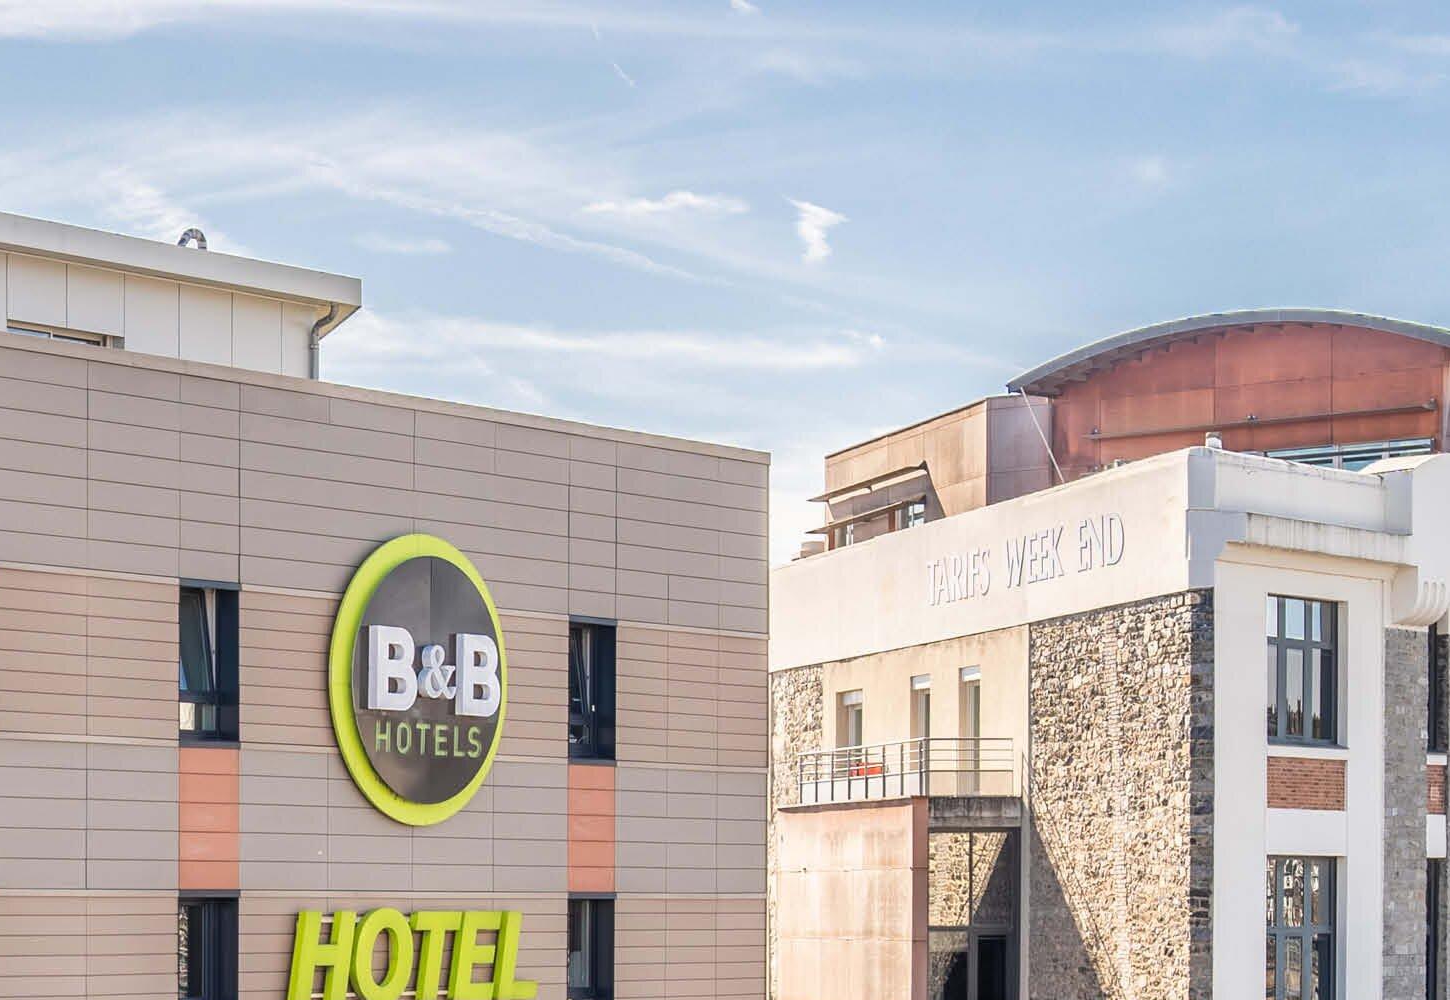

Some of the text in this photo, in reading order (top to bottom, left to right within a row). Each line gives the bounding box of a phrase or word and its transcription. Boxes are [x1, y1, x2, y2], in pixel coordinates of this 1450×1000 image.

[927, 512, 1125, 606] TARIFS WEEK END
[368, 624, 501, 718] B&B
[375, 719, 483, 758] HOTELS
